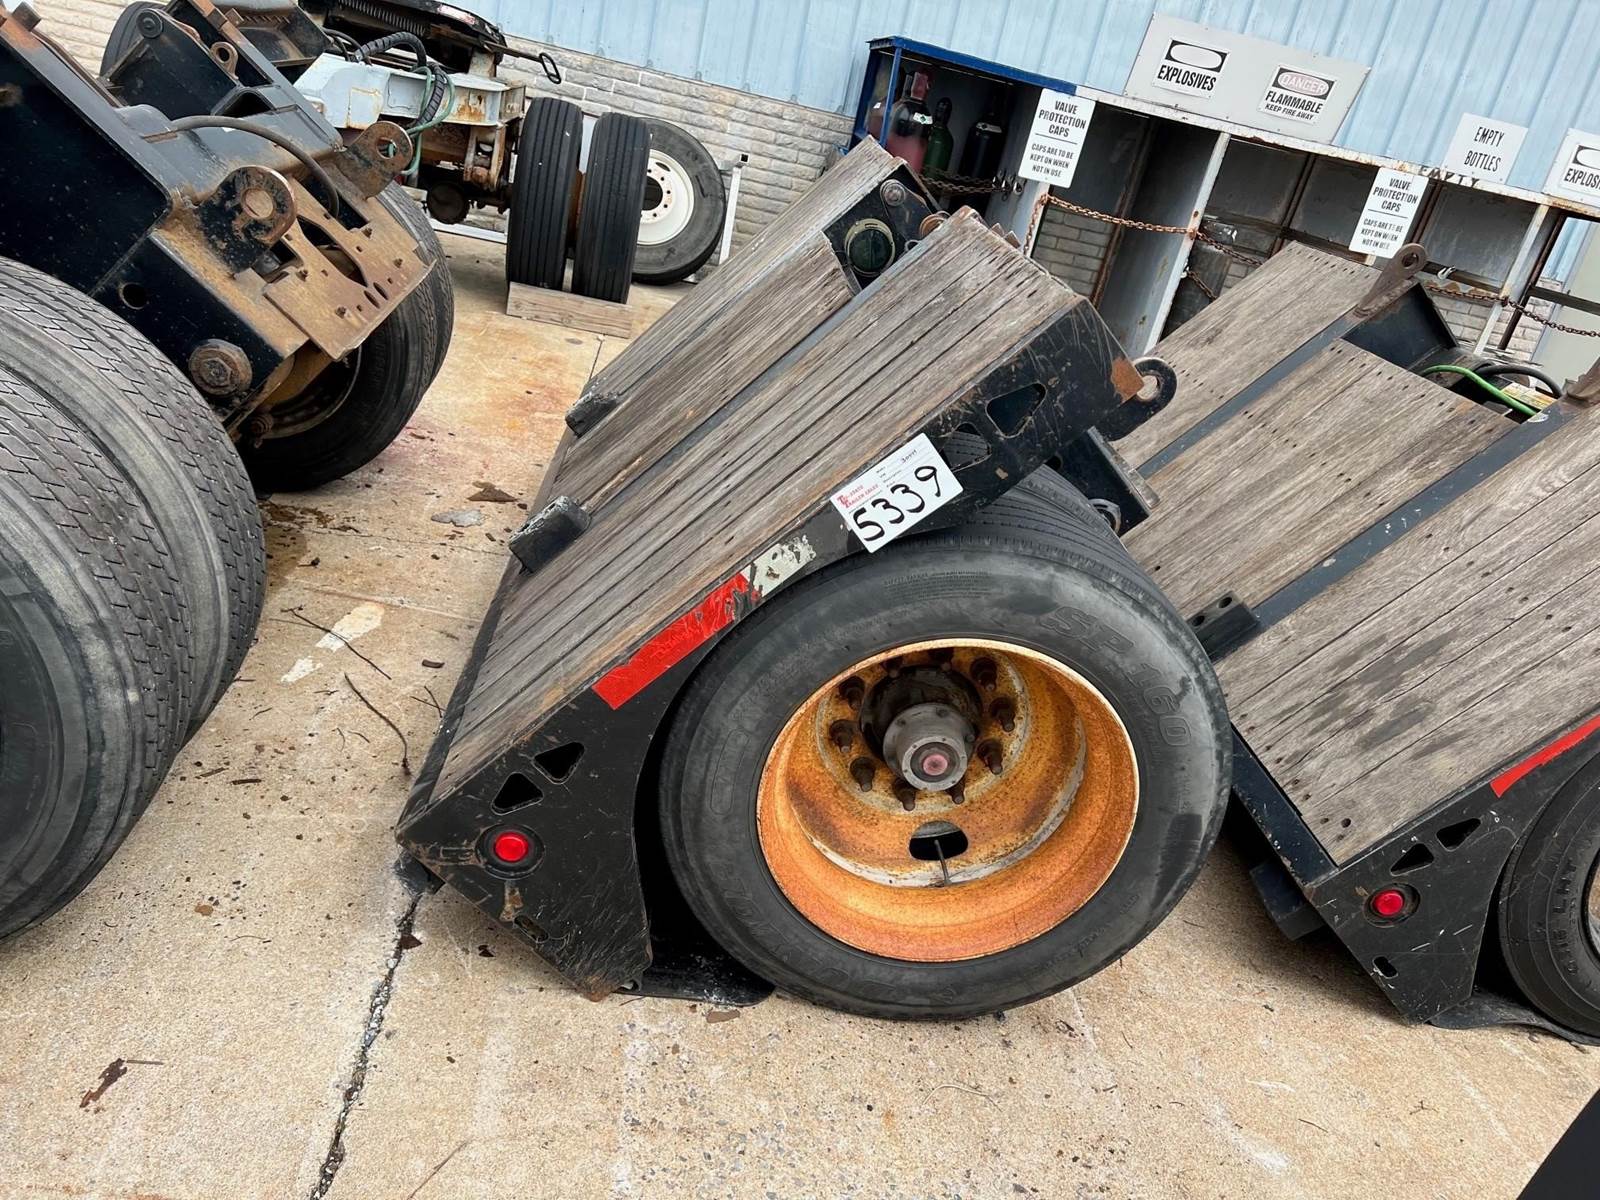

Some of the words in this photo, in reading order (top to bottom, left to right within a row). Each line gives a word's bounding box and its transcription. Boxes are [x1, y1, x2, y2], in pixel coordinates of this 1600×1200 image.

[1157, 64, 1217, 91] EXPLOSIVES
[1281, 73, 1329, 96] DANGER
[1054, 100, 1078, 115] VALVE
[1265, 90, 1324, 114] FLAMMABLE
[1038, 109, 1087, 129] PROTECTION
[1264, 103, 1282, 114] KEEP
[1282, 106, 1296, 117] FIRE
[1296, 110, 1315, 121] AWAY
[1048, 124, 1070, 138] CAPS
[1473, 126, 1505, 148] EMPTY
[1031, 143, 1046, 153] CAPS
[1047, 146, 1058, 156] ARE
[1058, 149, 1066, 158] TO
[1066, 151, 1074, 160] BE
[1030, 154, 1044, 163] KEPT
[1044, 157, 1052, 165] ON
[1053, 159, 1070, 169] WHEN
[1463, 150, 1501, 173] BOTTLES
[1032, 165, 1044, 173] NOT
[1050, 169, 1062, 177] USE
[1564, 168, 1600, 190] EXPLOSI
[1389, 178, 1411, 191] VALVE
[1373, 186, 1419, 205] PROTECTION
[1381, 200, 1402, 213] CAPS
[1363, 218, 1378, 228] CAPS
[1377, 221, 1389, 230] ARE
[1361, 228, 1375, 237] KEPT
[1374, 231, 1382, 239] ON
[1362, 238, 1374, 246] NOT
[852, 465, 942, 542] 5339
[1039, 605, 1136, 654] SP
[1122, 662, 1192, 746] 160
